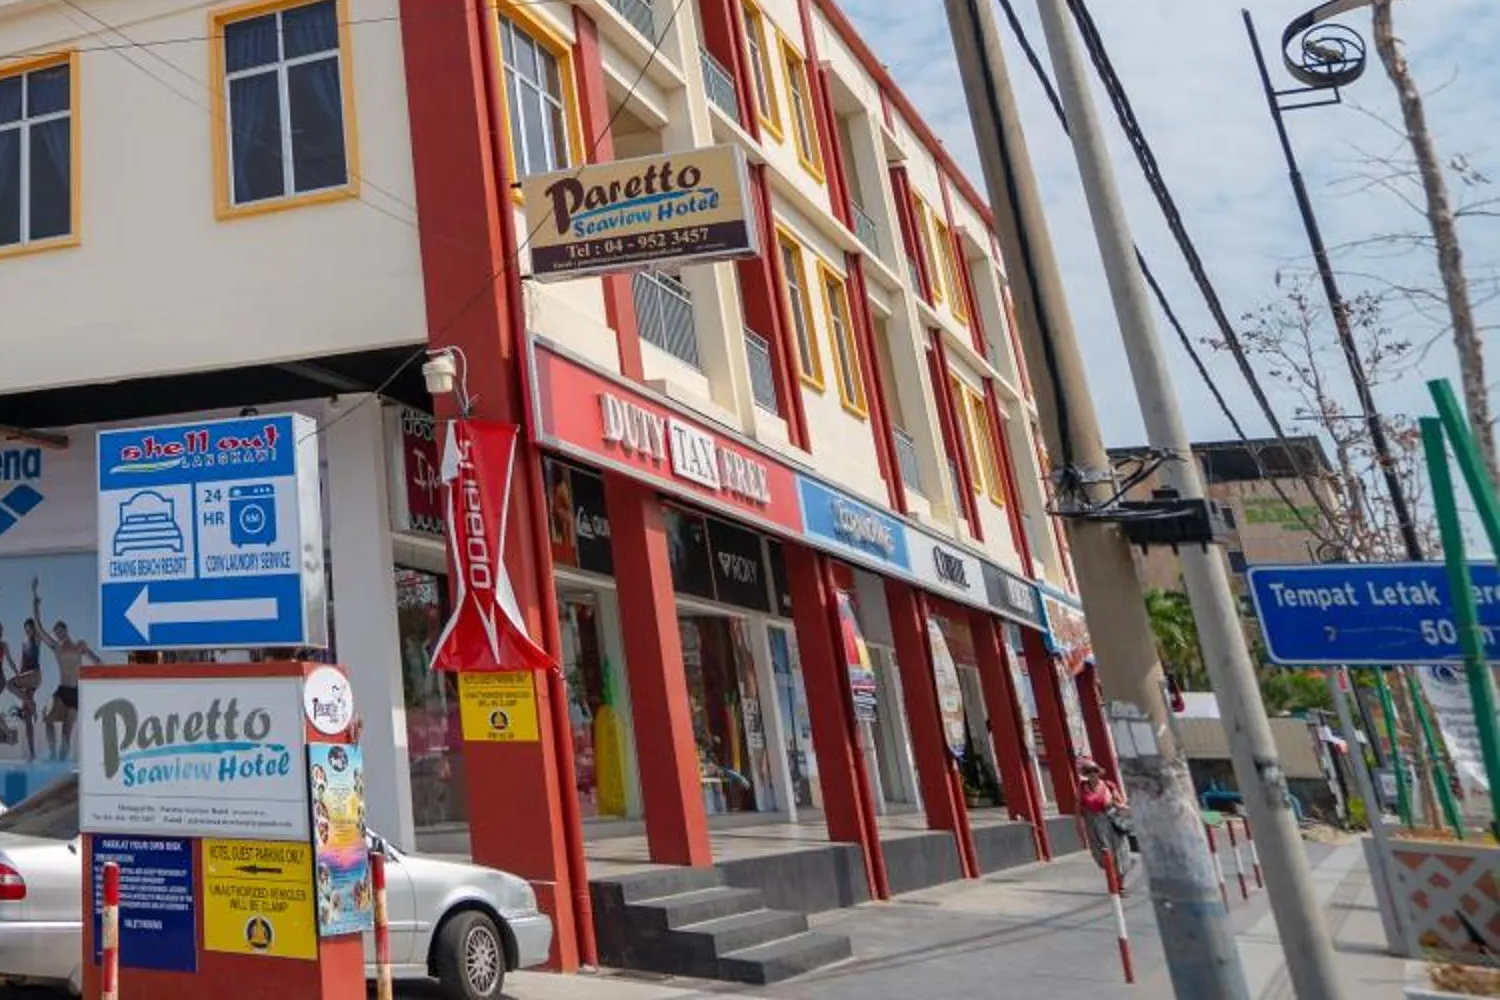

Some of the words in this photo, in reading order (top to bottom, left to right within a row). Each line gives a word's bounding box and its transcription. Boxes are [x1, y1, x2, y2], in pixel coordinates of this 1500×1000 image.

[545, 161, 701, 235] Paretto
[572, 209, 652, 238] Seaview
[658, 191, 719, 222] Hotel
[566, 244, 590, 259] Tel
[604, 240, 623, 254] 04
[638, 234, 667, 249] 952
[671, 228, 709, 246] 3457
[602, 392, 667, 461] DUTY
[673, 424, 715, 481] TAX
[204, 489, 222, 503] 24
[204, 512, 225, 526] HR
[1268, 582, 1359, 609] Tempat
[1367, 580, 1441, 606] Letak
[1420, 618, 1458, 646] 50
[94, 697, 271, 780] Paretto
[123, 756, 214, 788] Seaview
[218, 751, 290, 782] Hotel
